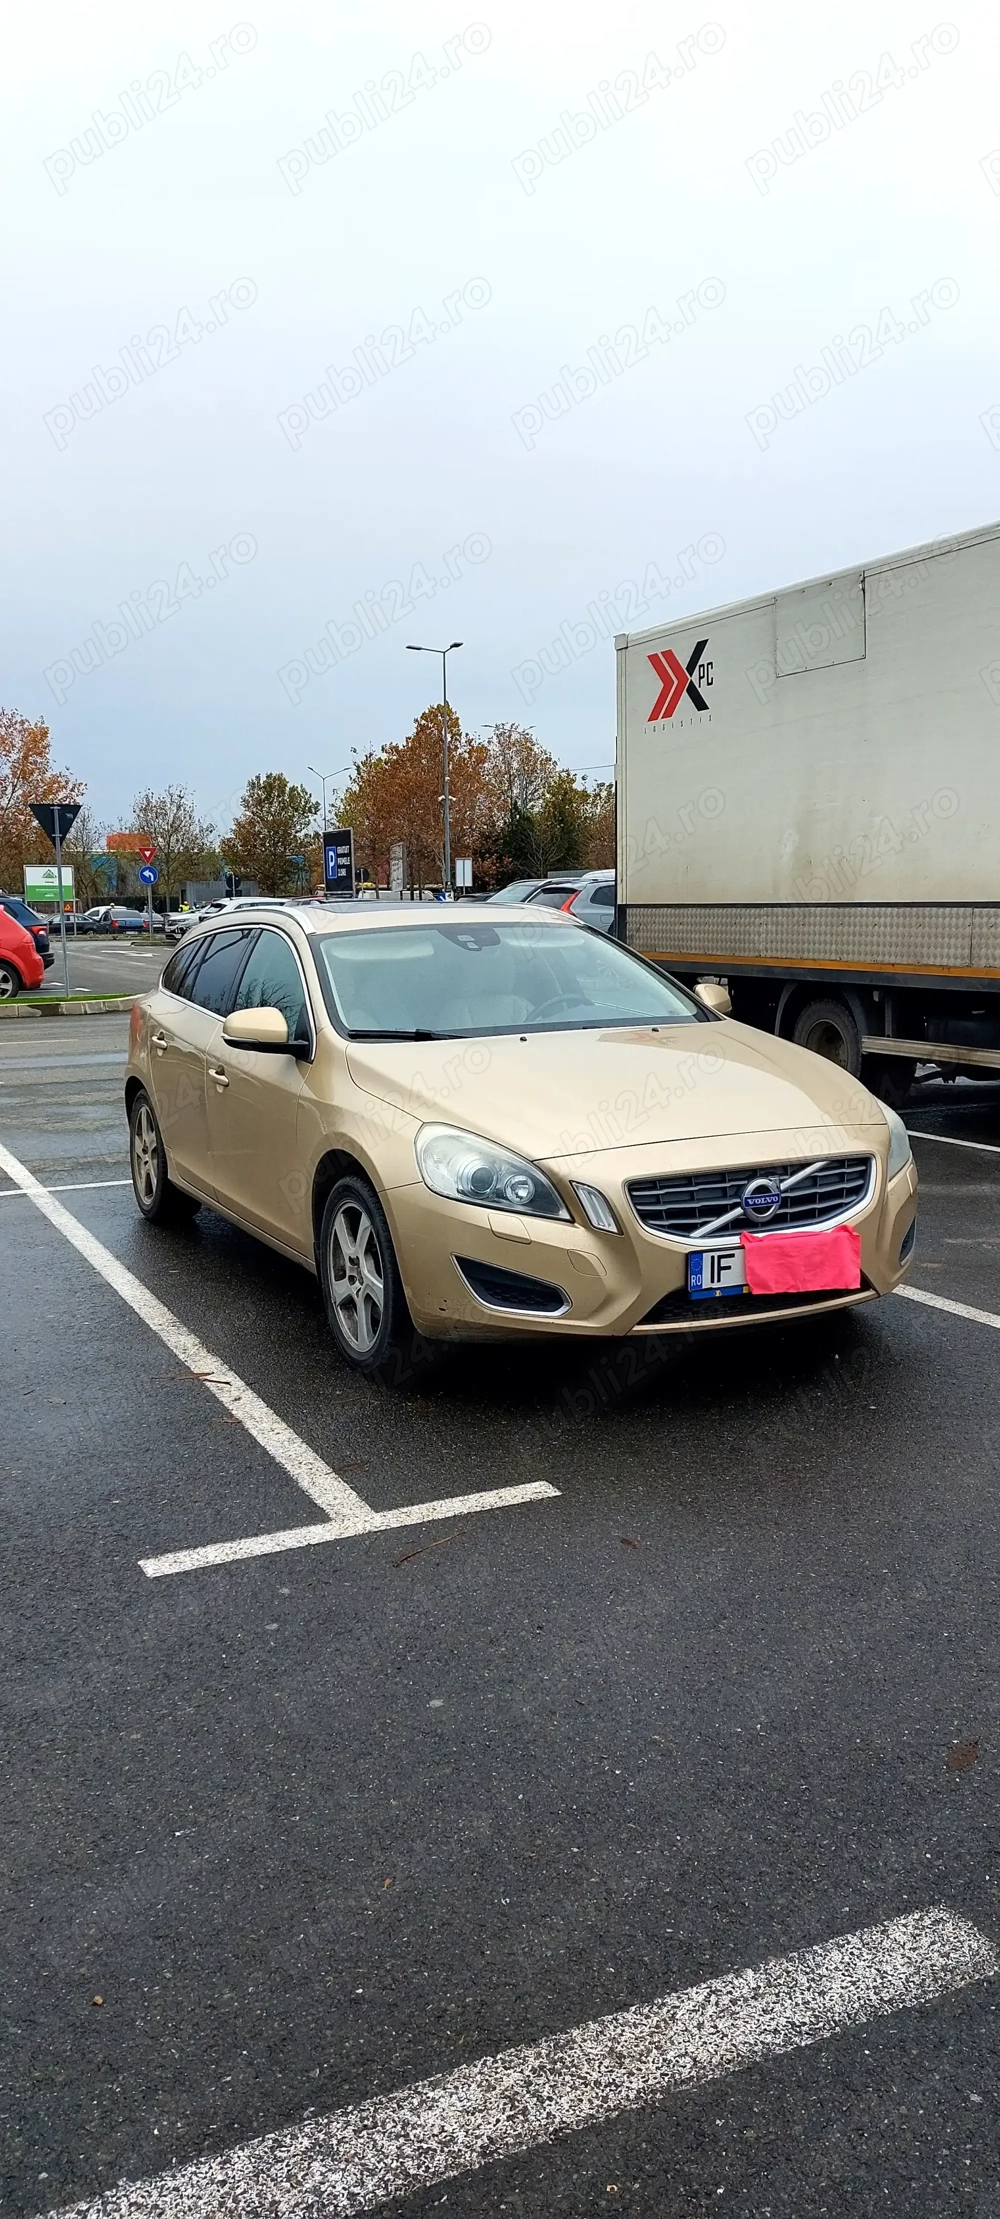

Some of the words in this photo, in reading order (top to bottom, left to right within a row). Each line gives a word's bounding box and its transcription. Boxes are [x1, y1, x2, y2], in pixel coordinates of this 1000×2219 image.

[747, 1195, 779, 1205] VOLVO
[710, 1253, 735, 1284] IF
[691, 1274, 702, 1286] RO
